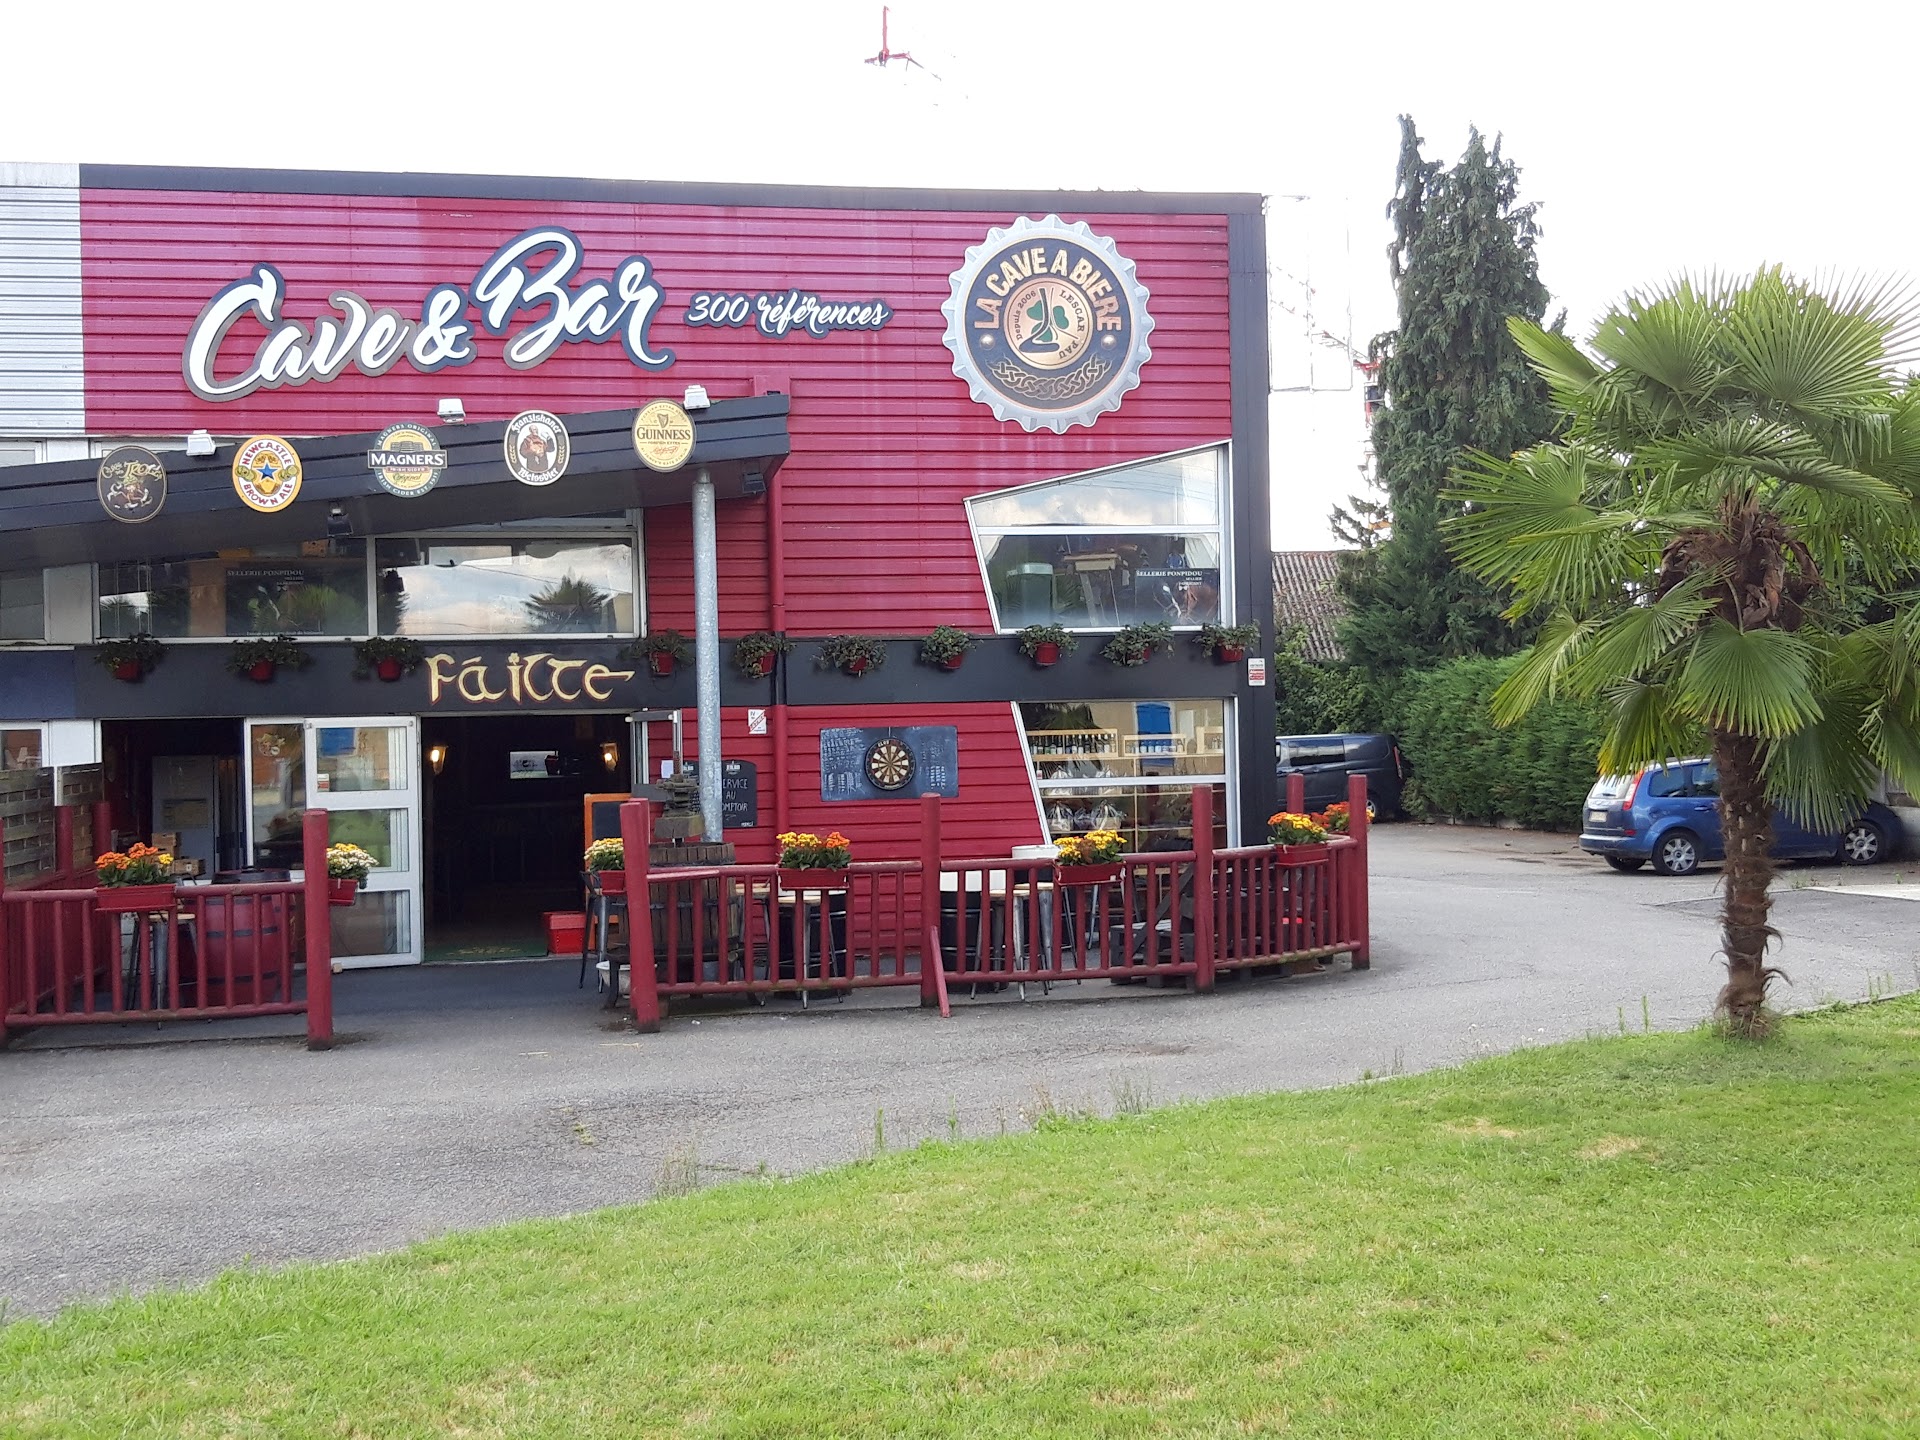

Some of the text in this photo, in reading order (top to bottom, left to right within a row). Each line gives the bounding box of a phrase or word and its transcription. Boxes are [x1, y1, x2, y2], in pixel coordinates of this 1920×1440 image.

[974, 247, 1123, 332] LA CAVE A BIERE
[188, 230, 670, 395] Cave & Bar
[688, 291, 889, 335] 300 références
[1012, 290, 1037, 341] Depuis 2006
[1058, 289, 1085, 332] LESCAR
[1058, 340, 1079, 360] PAU
[376, 424, 437, 447] MAGNERS ORIGINAL
[636, 426, 692, 441] GUINNESS
[241, 441, 293, 466] NEWCASTLE
[371, 453, 444, 467] MAGNERS
[243, 483, 294, 506] BROWN ALE
[392, 488, 415, 497] CIDER
[723, 778, 749, 789] ERVICE
[726, 790, 737, 800] AU
[722, 802, 748, 812] OMPTOIR
